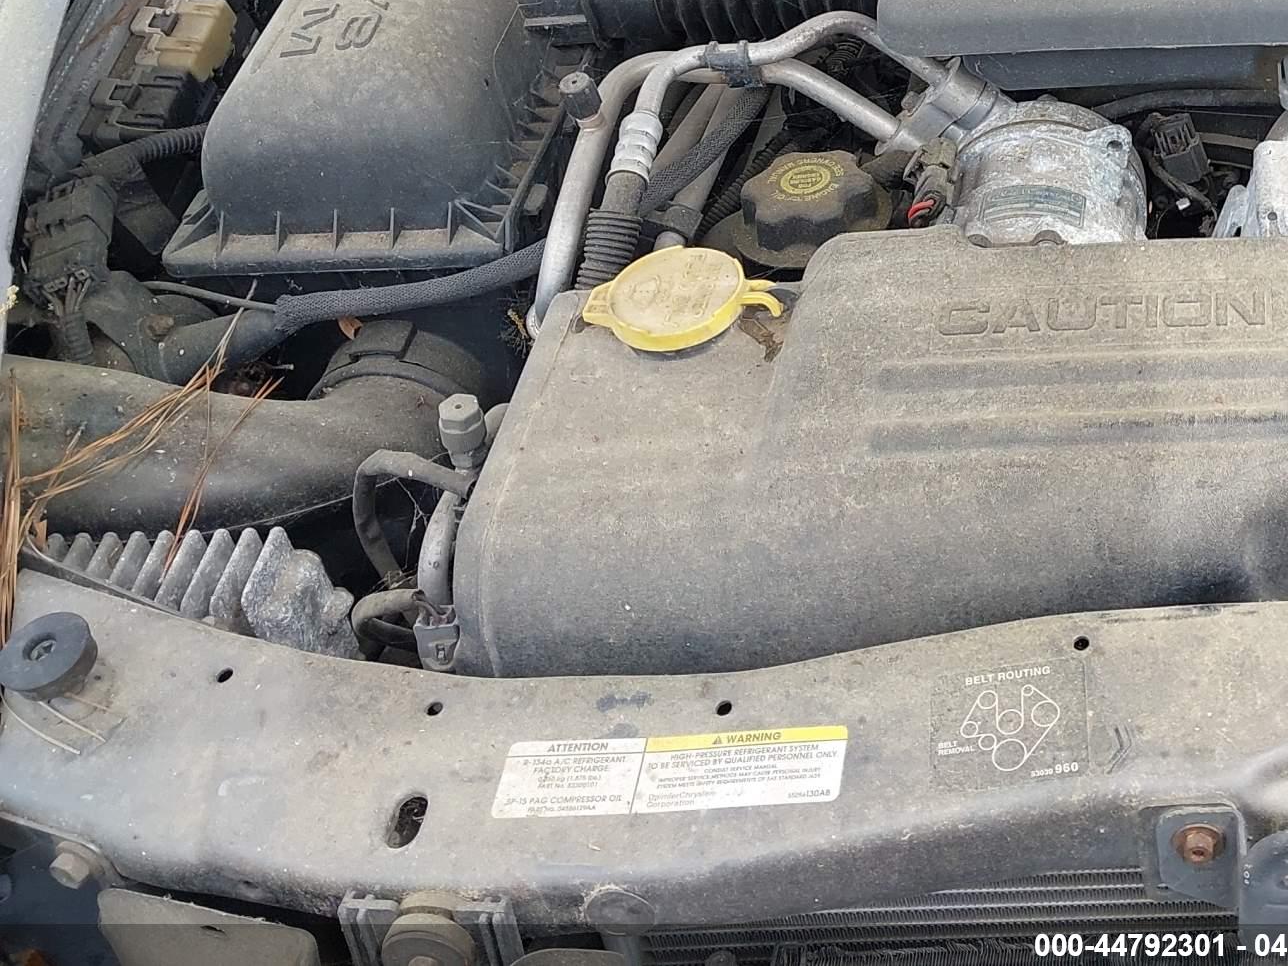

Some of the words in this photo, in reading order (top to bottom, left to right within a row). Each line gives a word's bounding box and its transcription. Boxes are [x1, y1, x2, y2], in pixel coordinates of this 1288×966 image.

[938, 290, 1266, 336] CAUTION
[965, 673, 995, 685] BELT
[997, 665, 1051, 682] ROUTING
[727, 732, 782, 743] WARNING
[547, 742, 609, 753] ATTENTION
[937, 740, 958, 749] BELT
[670, 749, 732, 761] HIGH-PRESSURE
[734, 746, 789, 757] REFRIGERANT
[789, 744, 820, 753] SYSTEM
[938, 745, 975, 756] REMOVAL
[572, 755, 626, 765] REFRIGERANT
[648, 763, 658, 771] TO
[660, 761, 671, 770] BE
[671, 759, 711, 769] SERVICED
[712, 757, 723, 766] BY
[724, 755, 766, 765] QUALIFIED
[767, 752, 815, 762] PERSONNEL
[533, 766, 571, 774] FACTORY
[573, 764, 609, 773] CHARGE
[1055, 762, 1079, 774] 960
[529, 796, 549, 805] PAG
[549, 794, 607, 804] COMPRESSOR
[608, 794, 622, 802] OIL
[646, 798, 695, 809] Corporation
